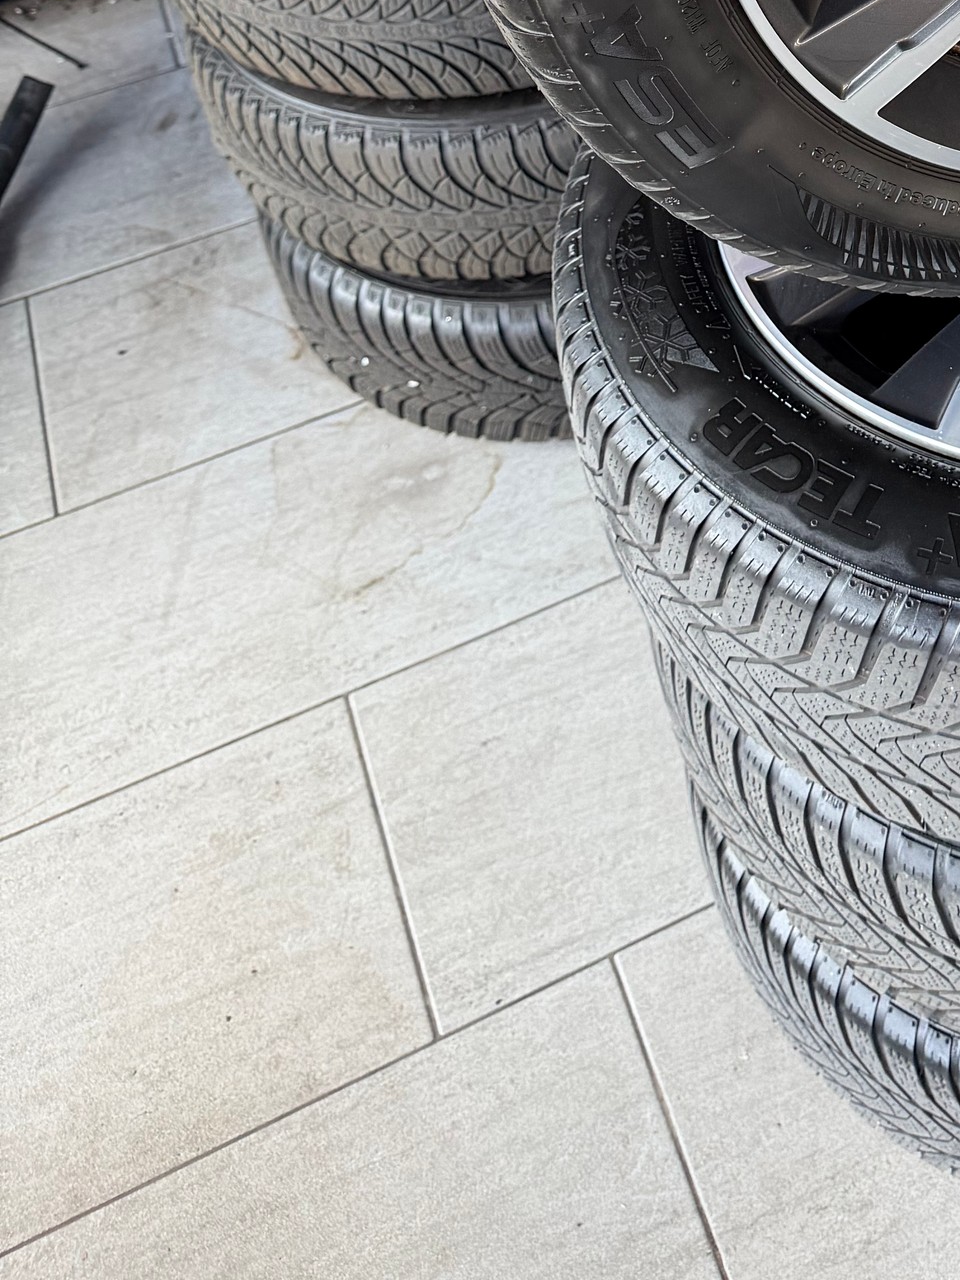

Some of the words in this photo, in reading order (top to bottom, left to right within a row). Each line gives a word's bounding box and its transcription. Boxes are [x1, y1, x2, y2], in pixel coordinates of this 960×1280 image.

[560, 0, 736, 170] ESA+
[811, 146, 878, 193] Europe
[876, 179, 898, 200] in
[701, 396, 885, 541] TECAR
